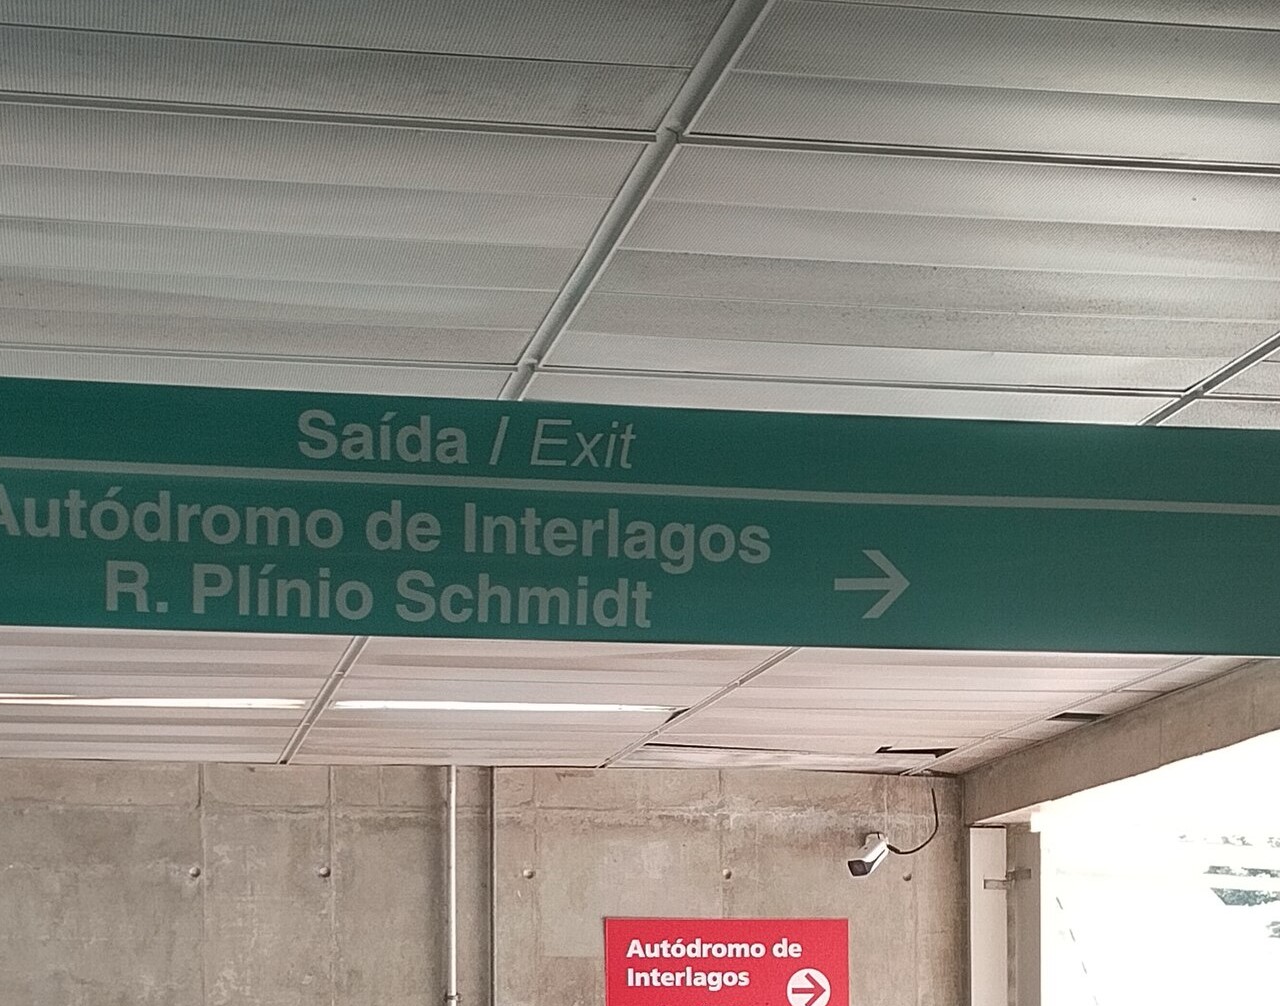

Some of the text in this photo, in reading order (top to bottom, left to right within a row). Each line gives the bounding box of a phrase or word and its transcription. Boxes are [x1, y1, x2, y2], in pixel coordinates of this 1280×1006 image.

[297, 409, 637, 469] Saída / Exit
[365, 499, 442, 552] de
[464, 502, 772, 574] Interlagos
[105, 560, 653, 628] R. Plínio Schmidt
[626, 938, 803, 958] Autódromo de
[626, 966, 750, 992] Interlagos
